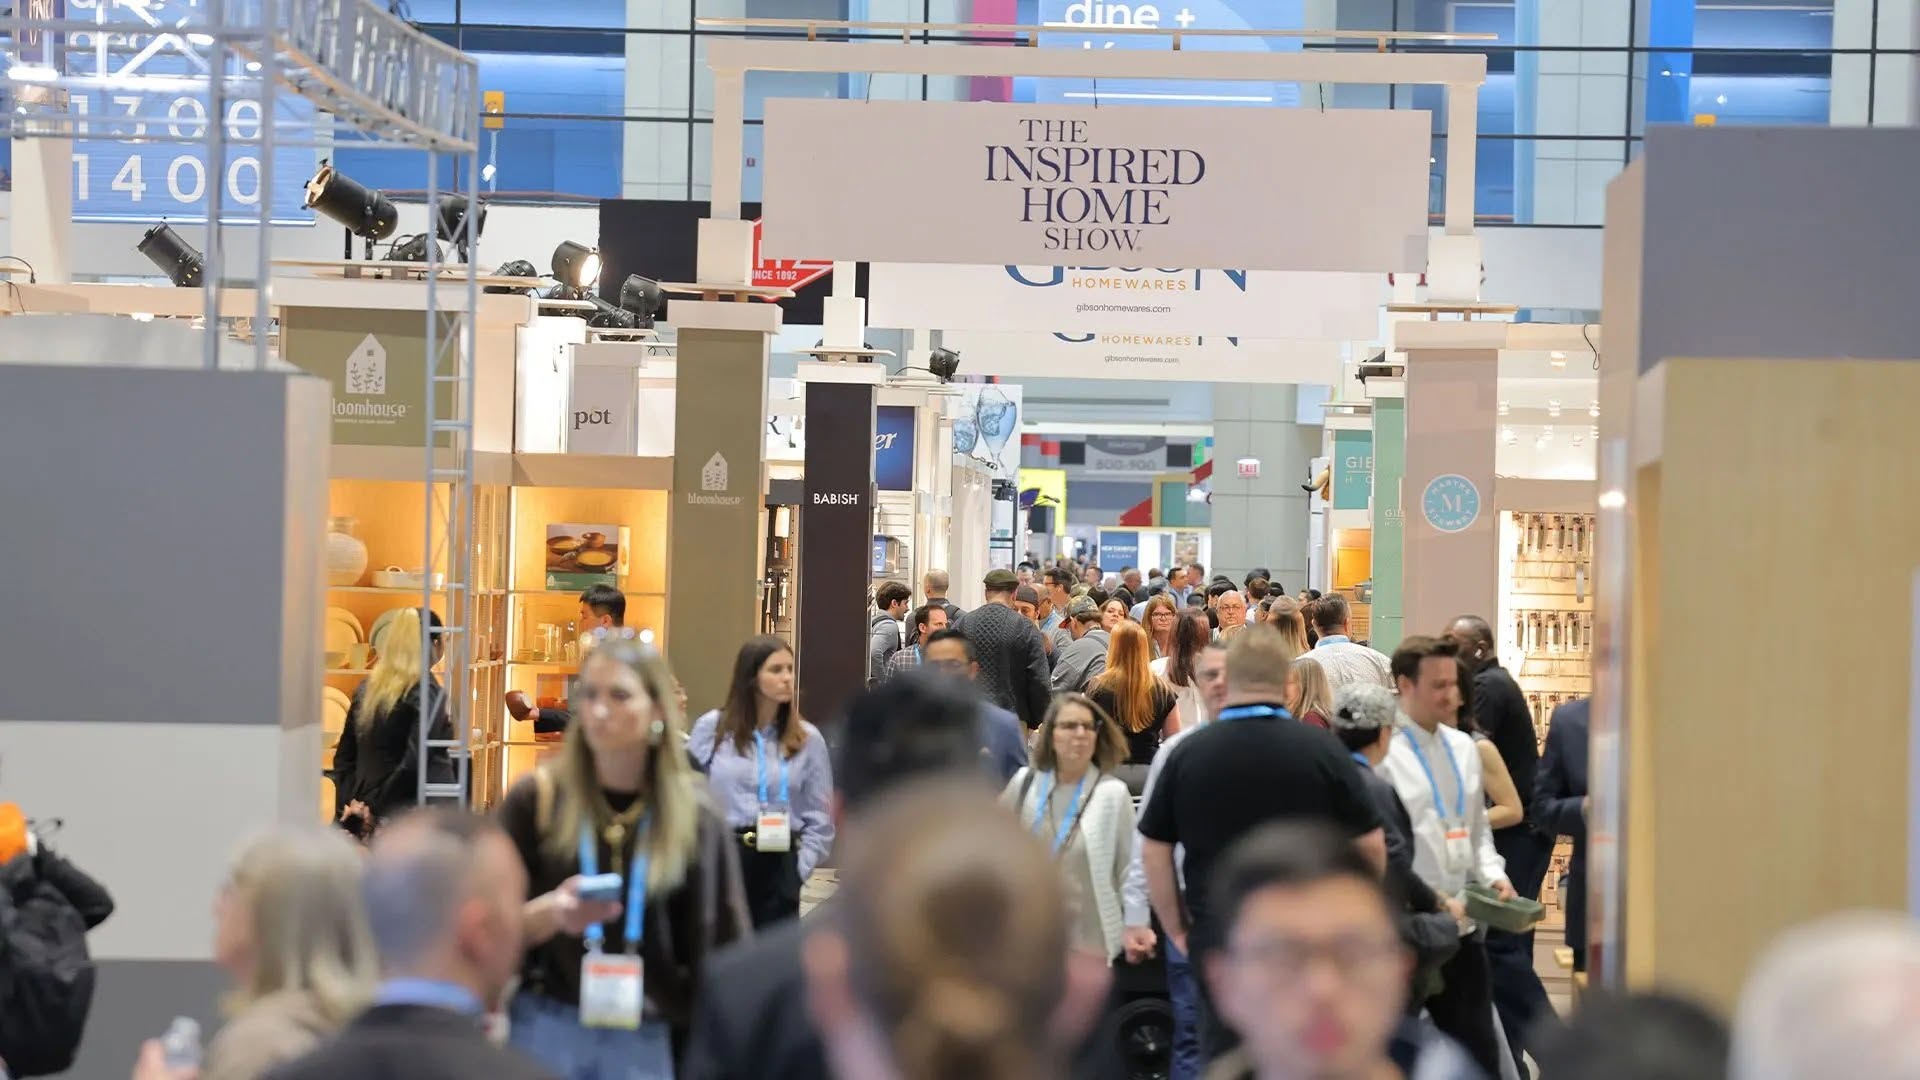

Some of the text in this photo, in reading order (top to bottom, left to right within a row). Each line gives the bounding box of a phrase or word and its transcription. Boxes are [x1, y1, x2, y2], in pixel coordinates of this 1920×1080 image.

[1065, 0, 1160, 28] dine
[1019, 119, 1088, 143] THE
[985, 145, 1206, 185] INSPIRED
[72, 153, 262, 204] 1400
[1020, 187, 1171, 225] HOME
[751, 270, 798, 280] INCE 1892
[1072, 278, 1186, 291] HOMEWARES
[1076, 303, 1171, 314] gibsonhomewares.com
[1101, 335, 1191, 346] HOMEWARES
[332, 397, 406, 417] loomhouse
[813, 493, 858, 505] BABISH
[1440, 494, 1462, 513] M
